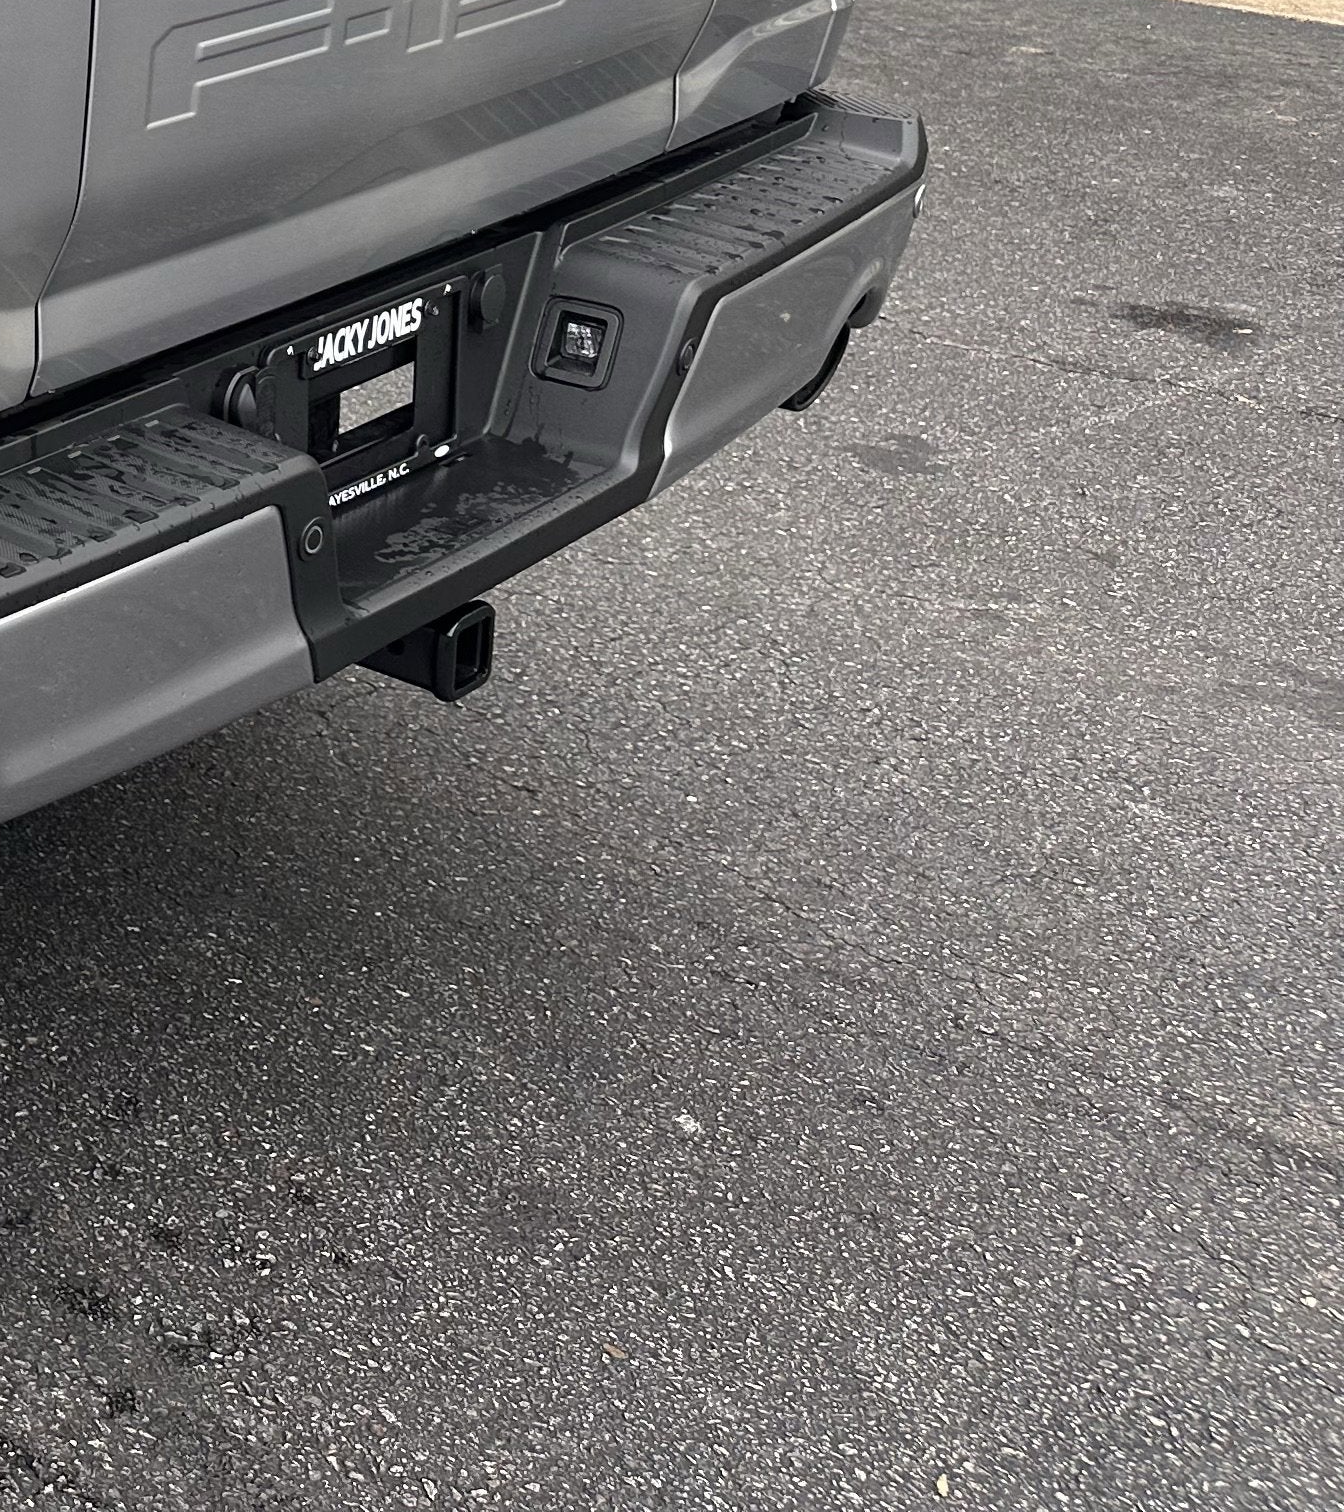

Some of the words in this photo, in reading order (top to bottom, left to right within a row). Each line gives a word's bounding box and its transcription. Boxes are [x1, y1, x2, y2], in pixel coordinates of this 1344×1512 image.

[313, 318, 369, 372] JACKY
[368, 297, 423, 350] JONES
[328, 473, 387, 506] AYESVILLE,
